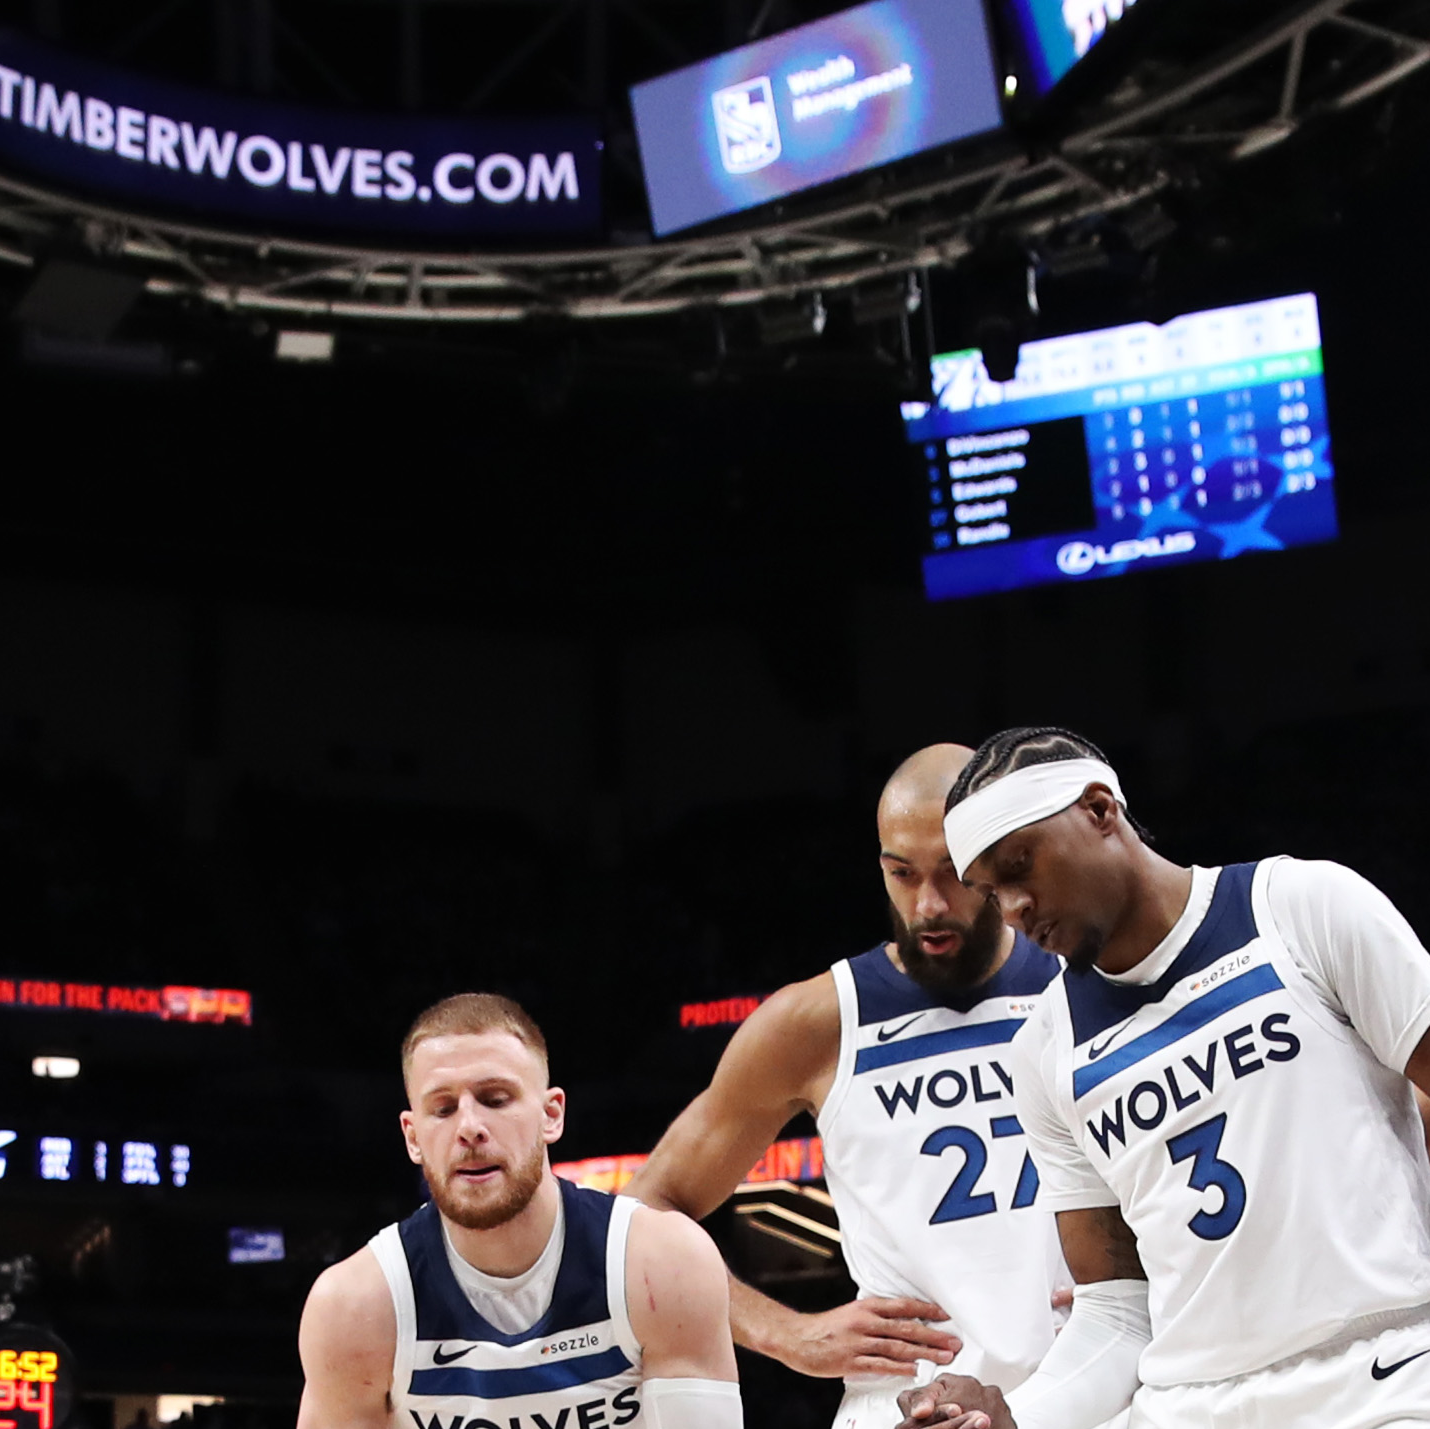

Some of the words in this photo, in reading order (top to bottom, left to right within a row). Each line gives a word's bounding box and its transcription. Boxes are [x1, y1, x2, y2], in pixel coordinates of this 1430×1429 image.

[1095, 532, 1196, 565] LEXUS
[20, 981, 61, 1006] FOR
[1201, 955, 1250, 987] sezzle
[874, 1061, 1014, 1119] WOLV
[1086, 1012, 1301, 1159] WOLVES
[920, 1115, 1040, 1225] 27
[1166, 1112, 1247, 1241] 3
[550, 1332, 600, 1354] sezzle
